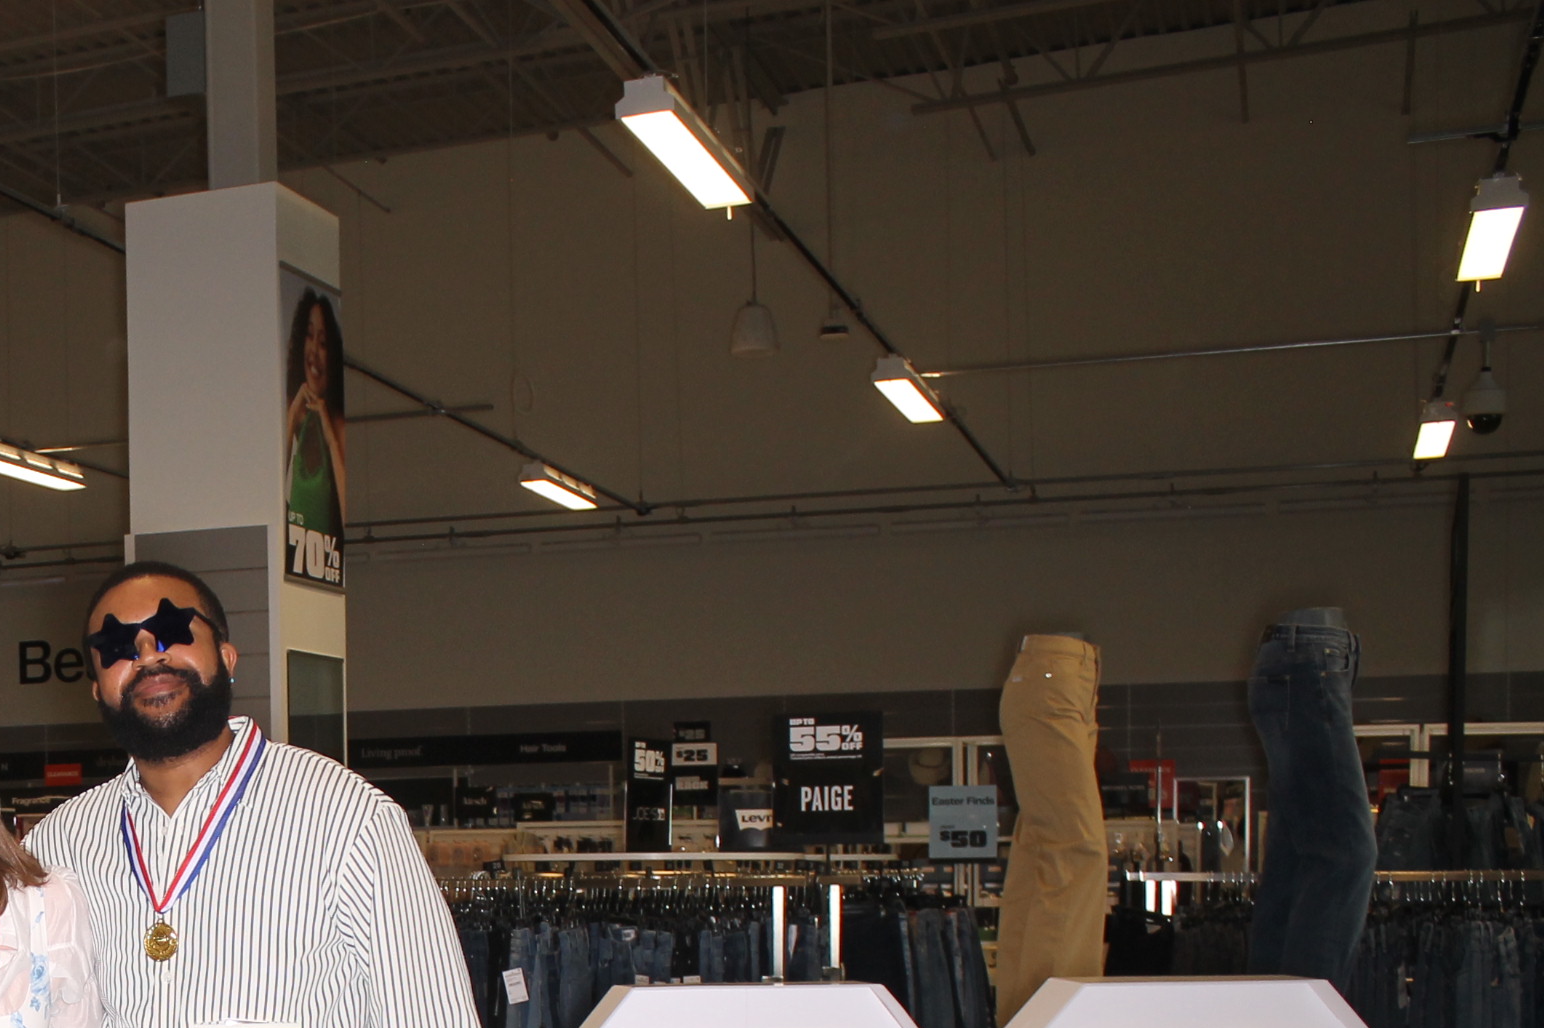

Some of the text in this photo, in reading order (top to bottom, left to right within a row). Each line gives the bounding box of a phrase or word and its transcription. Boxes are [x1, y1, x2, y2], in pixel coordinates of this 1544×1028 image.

[288, 523, 340, 583] 70% OFF
[19, 640, 97, 684] Be
[789, 724, 863, 752] 55% OFF
[676, 749, 708, 762] $25
[801, 785, 854, 811] PAIGE
[940, 830, 987, 848] $50
